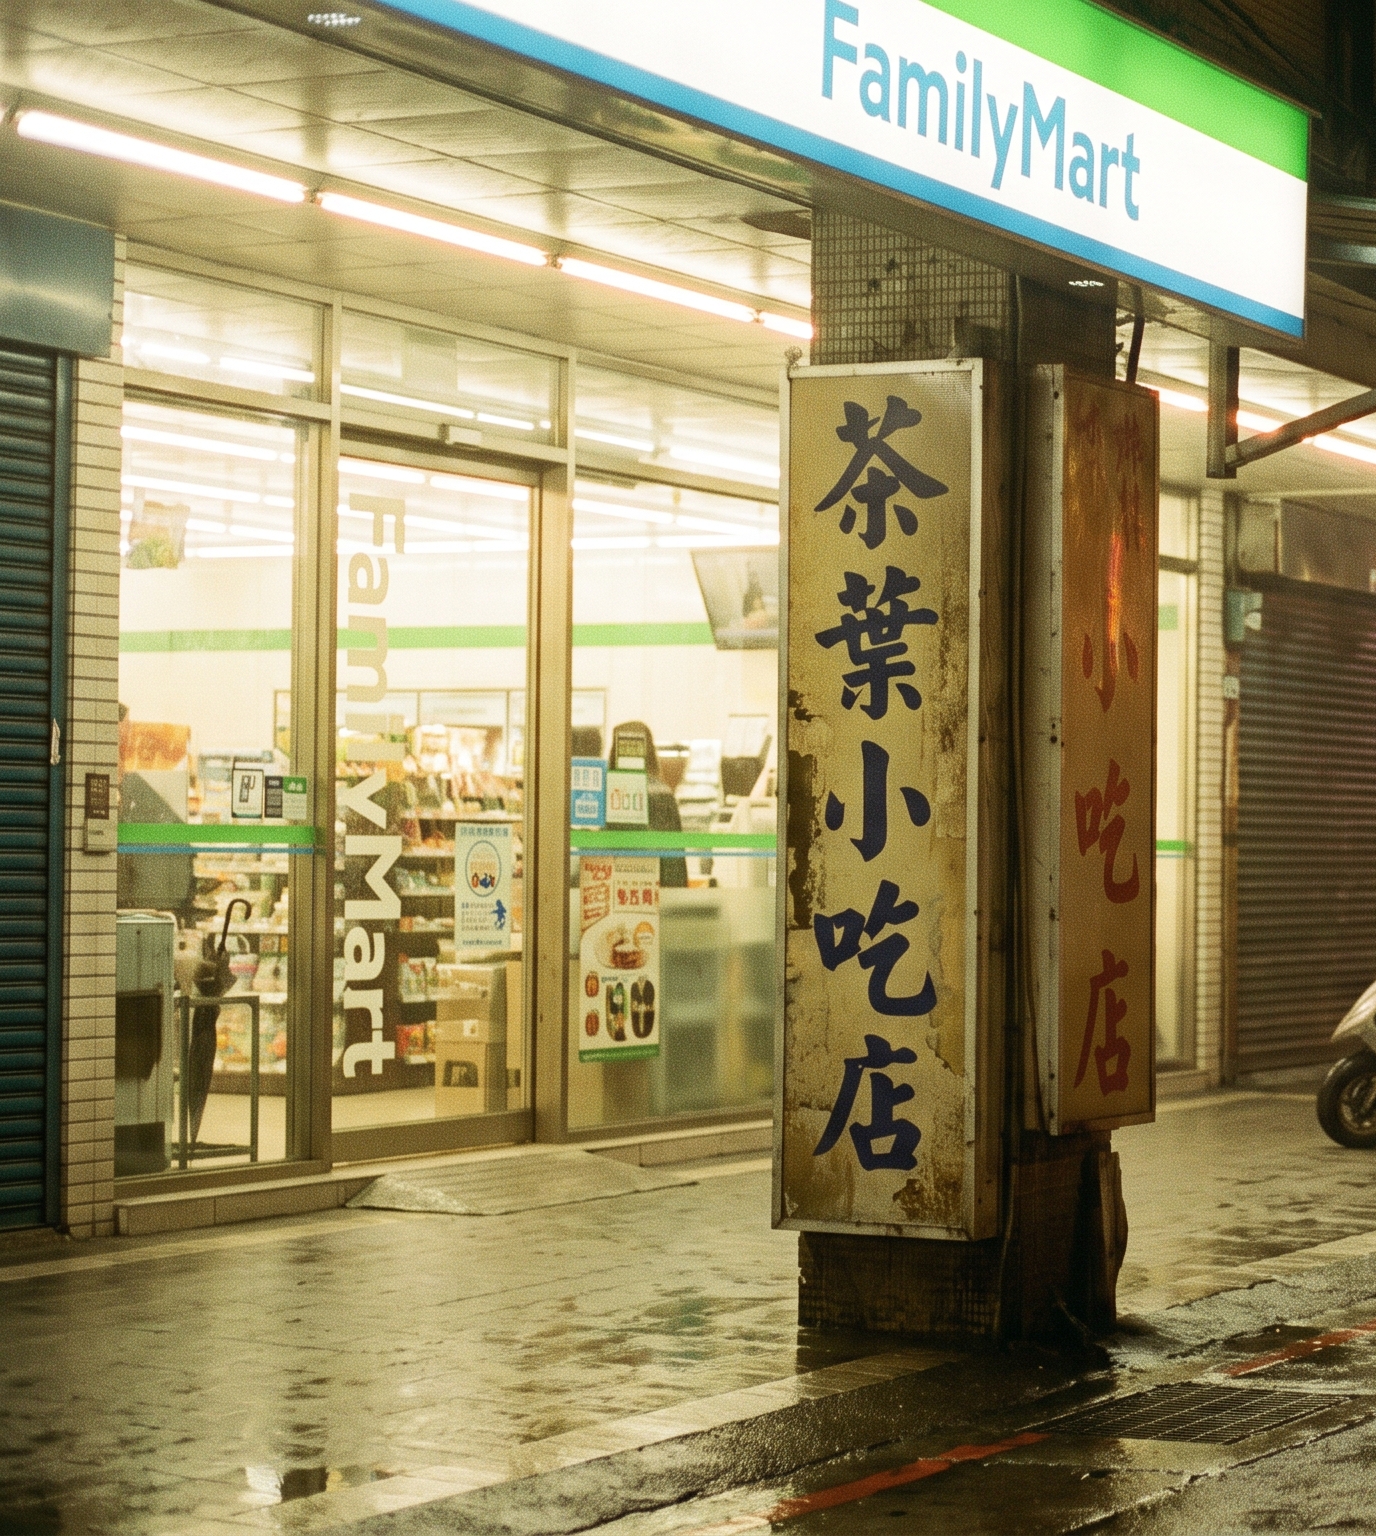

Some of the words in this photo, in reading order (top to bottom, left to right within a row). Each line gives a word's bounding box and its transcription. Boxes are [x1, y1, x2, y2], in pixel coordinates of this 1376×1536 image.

[821, 0, 1141, 221] FamilyMart
[338, 492, 406, 1078] FamilyMart
[812, 395, 949, 1171] 茶葉小吃店
[1073, 594, 1140, 1096] 小吃店
